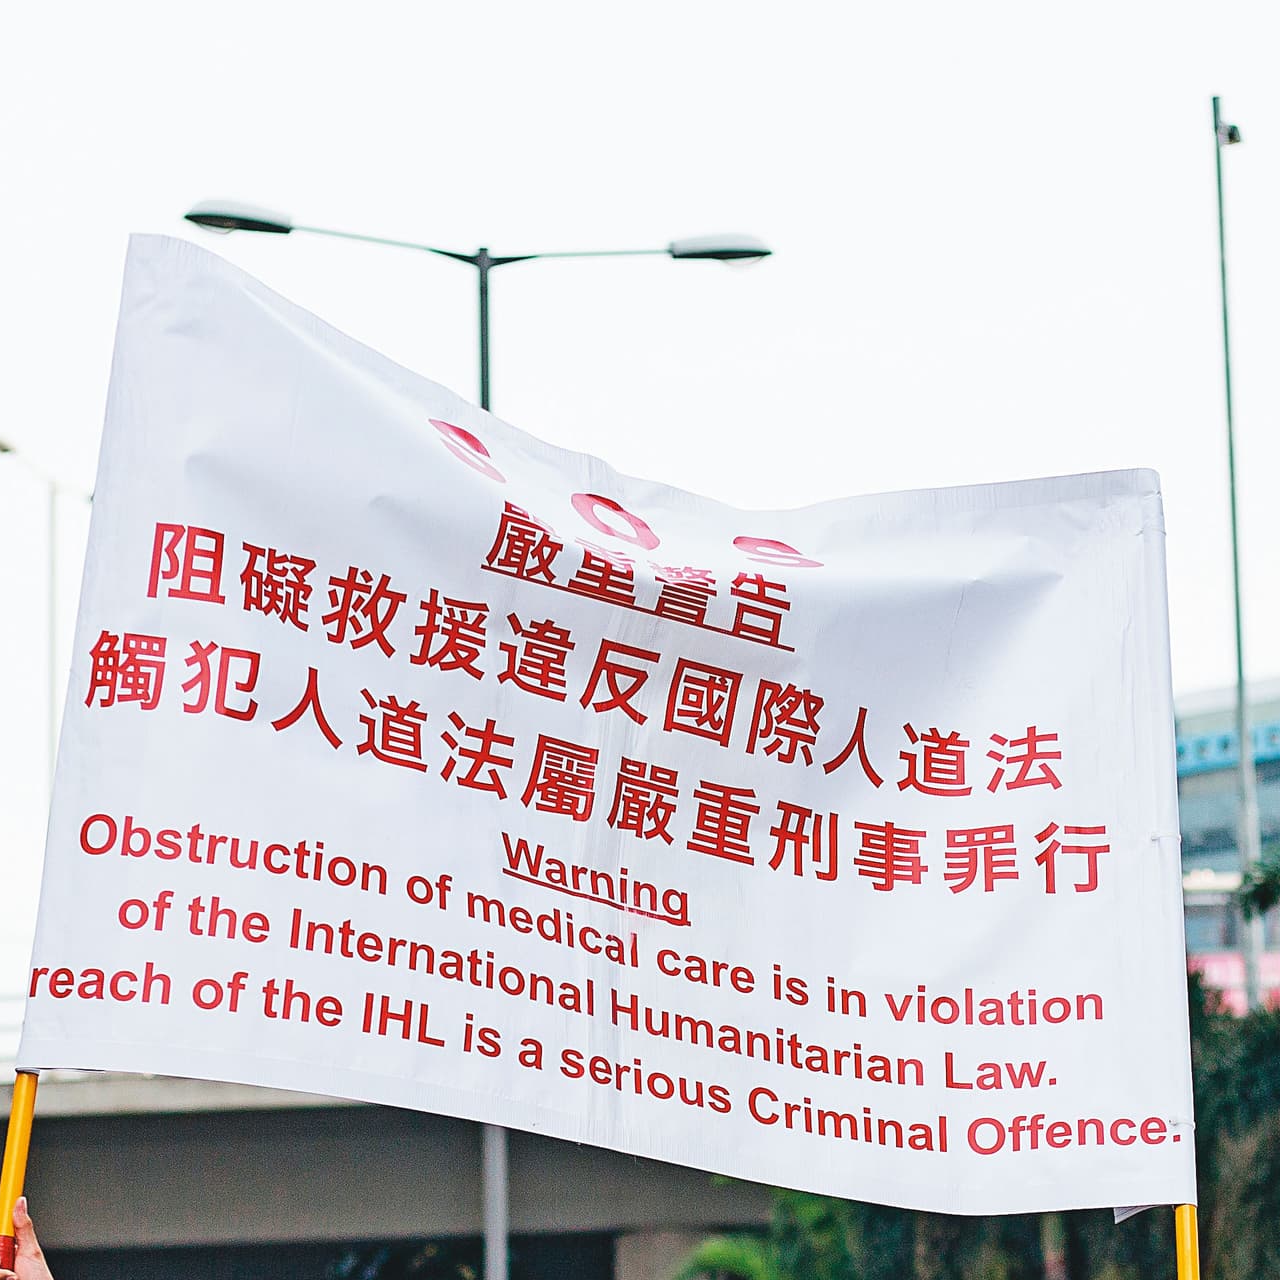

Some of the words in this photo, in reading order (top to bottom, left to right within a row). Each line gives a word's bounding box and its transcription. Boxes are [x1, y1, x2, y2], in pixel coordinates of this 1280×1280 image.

[147, 522, 1063, 796] 阻礙救援違反國際人道法
[481, 500, 794, 651] 嚴重警告
[85, 630, 1110, 895] 觸犯人道法屬嚴重刑事罪行
[80, 814, 388, 895] Obstruction
[406, 873, 453, 910] of
[468, 891, 639, 968] medical
[657, 949, 755, 993] care
[772, 964, 810, 1007] is
[827, 977, 867, 1018] in
[885, 985, 1104, 1026] violation
[501, 831, 690, 925] Warning
[28, 961, 171, 1005] reach
[192, 971, 248, 1012] of
[263, 978, 343, 1026] the
[362, 992, 446, 1047] IHL
[463, 1014, 501, 1057] is
[518, 1037, 544, 1070] a
[560, 1050, 732, 1113] serious
[748, 1086, 948, 1153] Criminal
[967, 1115, 1181, 1156] Offence.
[118, 890, 173, 930] of
[188, 895, 270, 943] the
[289, 908, 595, 1016] International
[611, 988, 923, 1086] Humanitarian
[945, 1052, 1058, 1090] Law.
